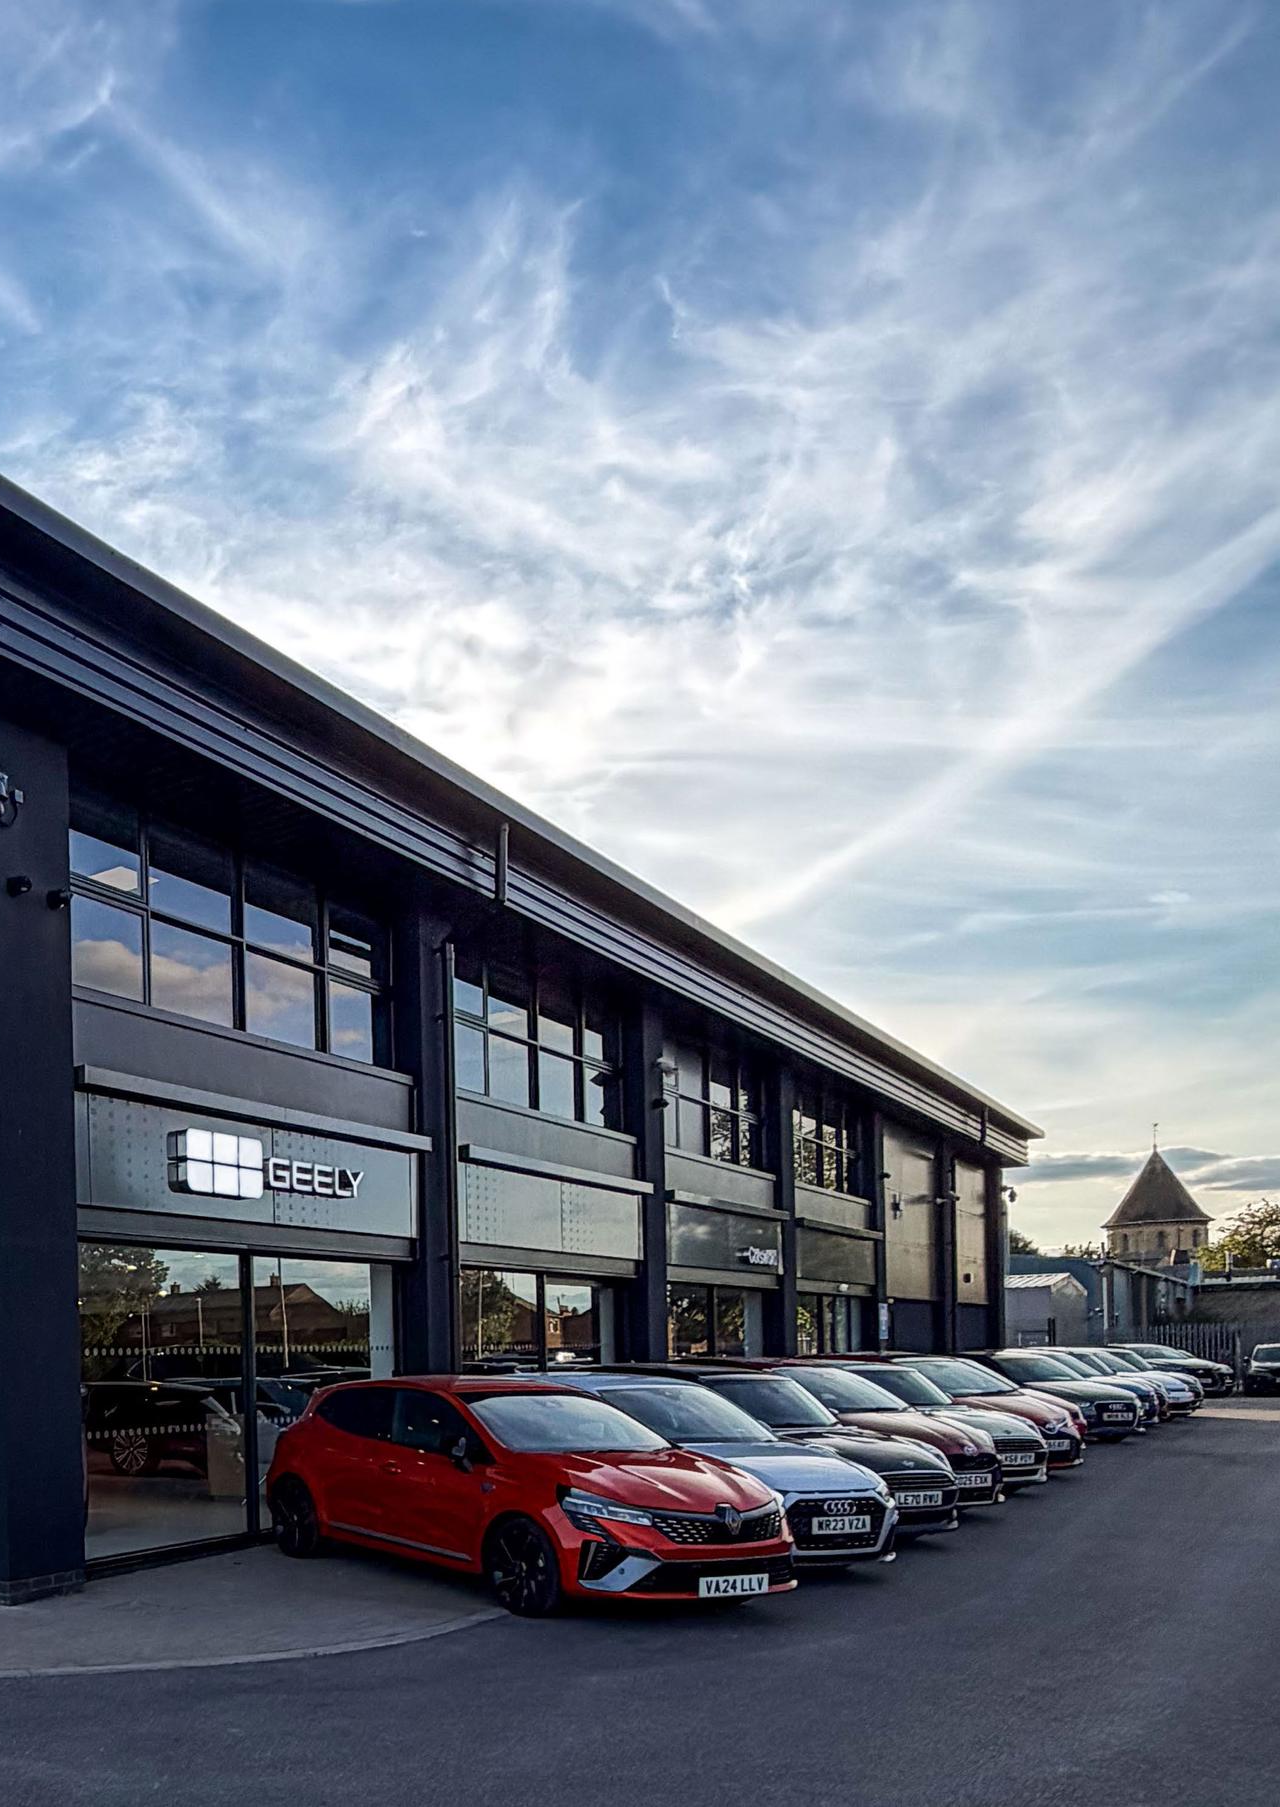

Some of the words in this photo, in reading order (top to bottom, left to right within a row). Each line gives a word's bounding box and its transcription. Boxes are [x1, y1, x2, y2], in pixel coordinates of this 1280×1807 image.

[269, 1157, 365, 1198] GEELY
[847, 1517, 867, 1530] VZA
[705, 1578, 738, 1595] VA24
[740, 1576, 765, 1593] LLV
